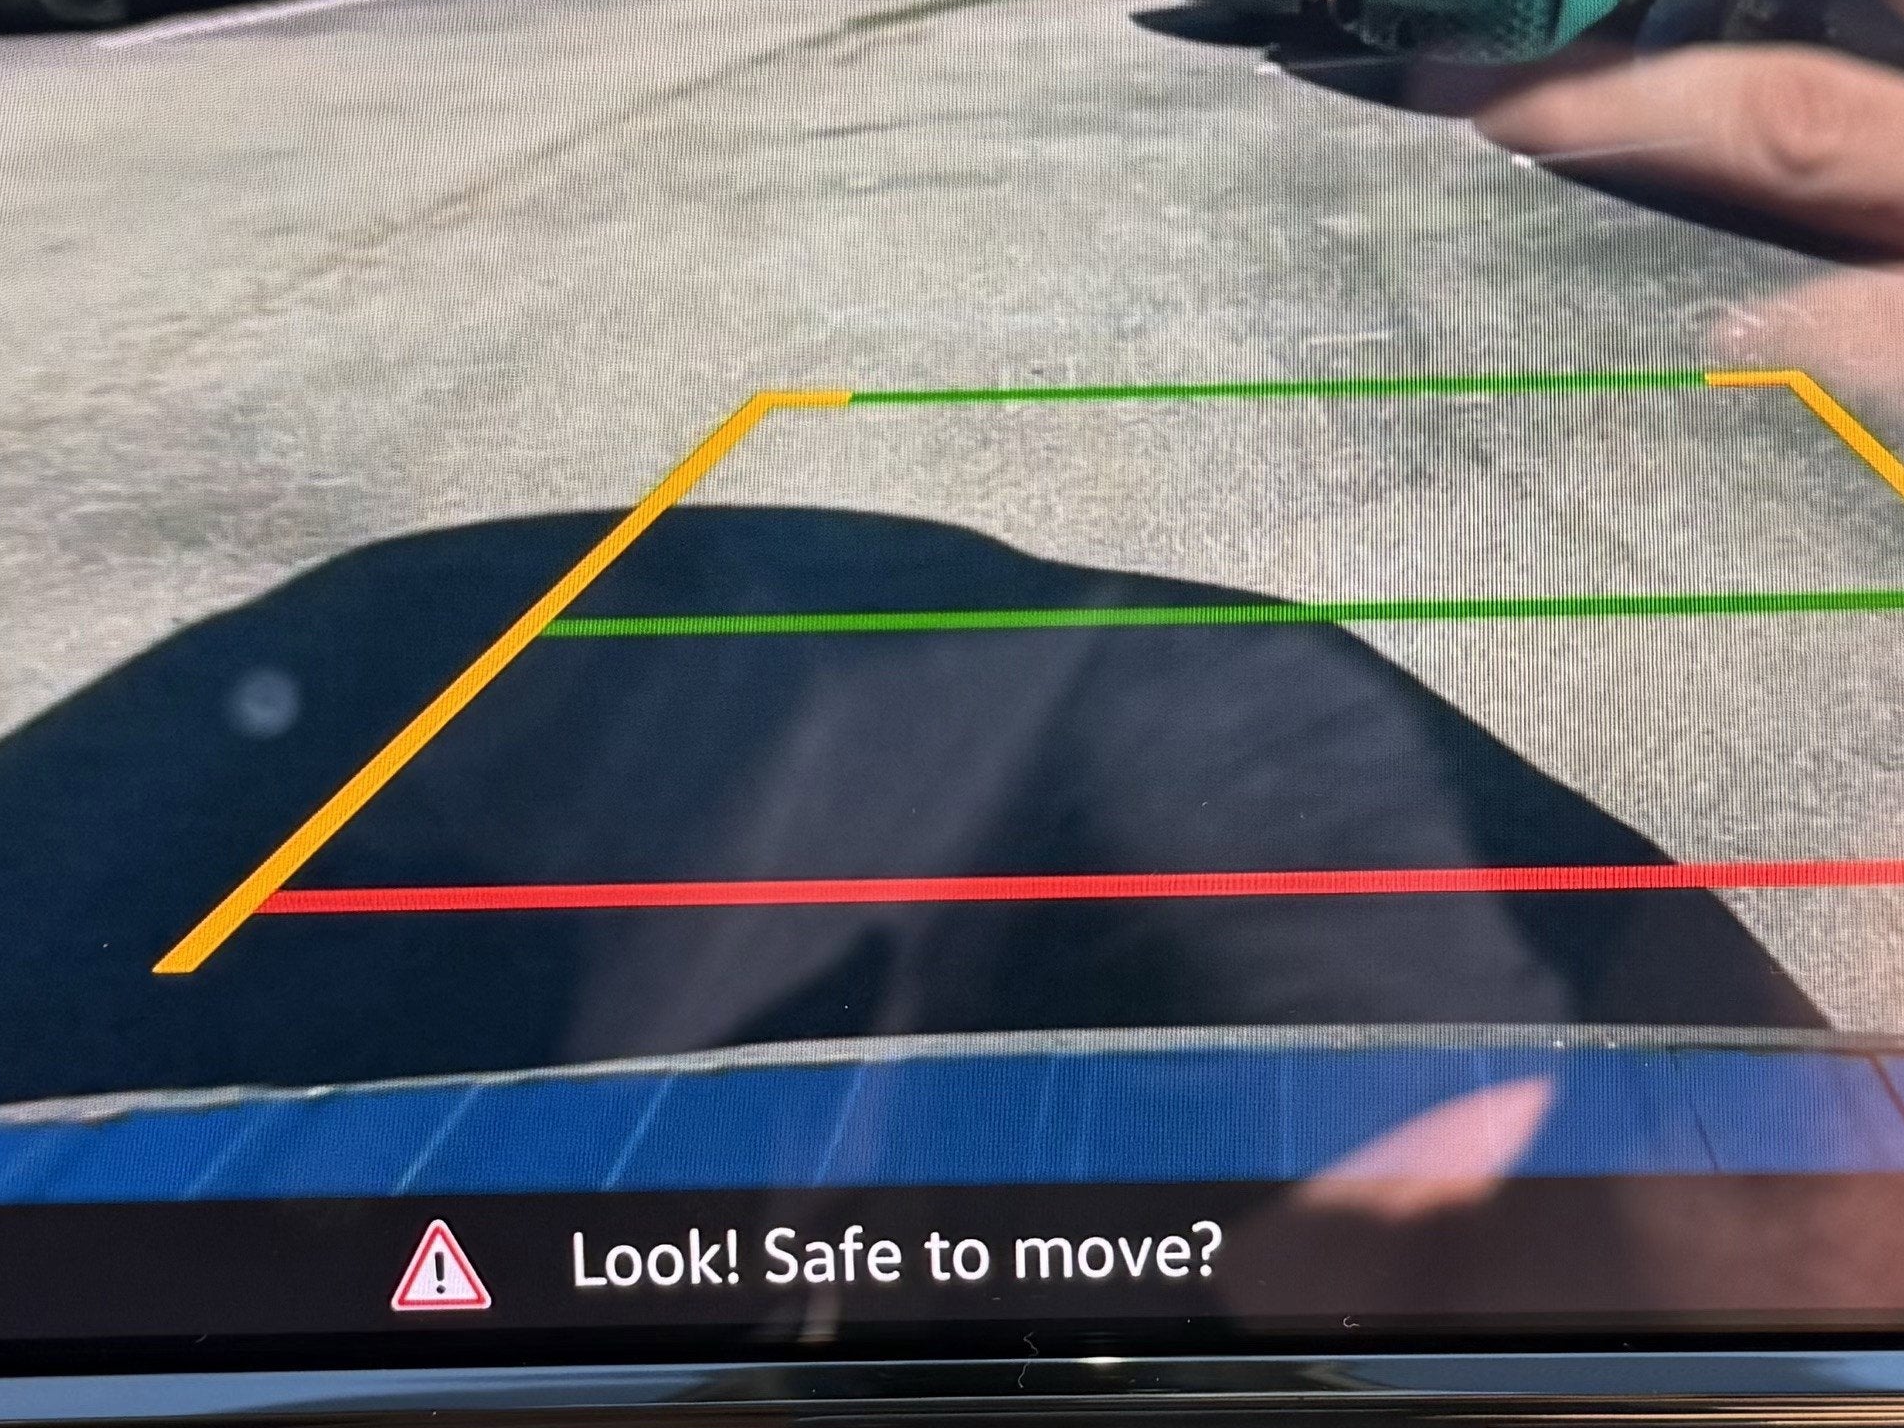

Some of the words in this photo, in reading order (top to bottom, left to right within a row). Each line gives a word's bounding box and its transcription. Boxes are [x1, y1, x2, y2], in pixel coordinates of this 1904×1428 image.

[571, 1226, 741, 1288] Look!
[762, 1222, 903, 1285] Safe
[922, 1229, 991, 1282] to
[1013, 1218, 1224, 1280] move?
